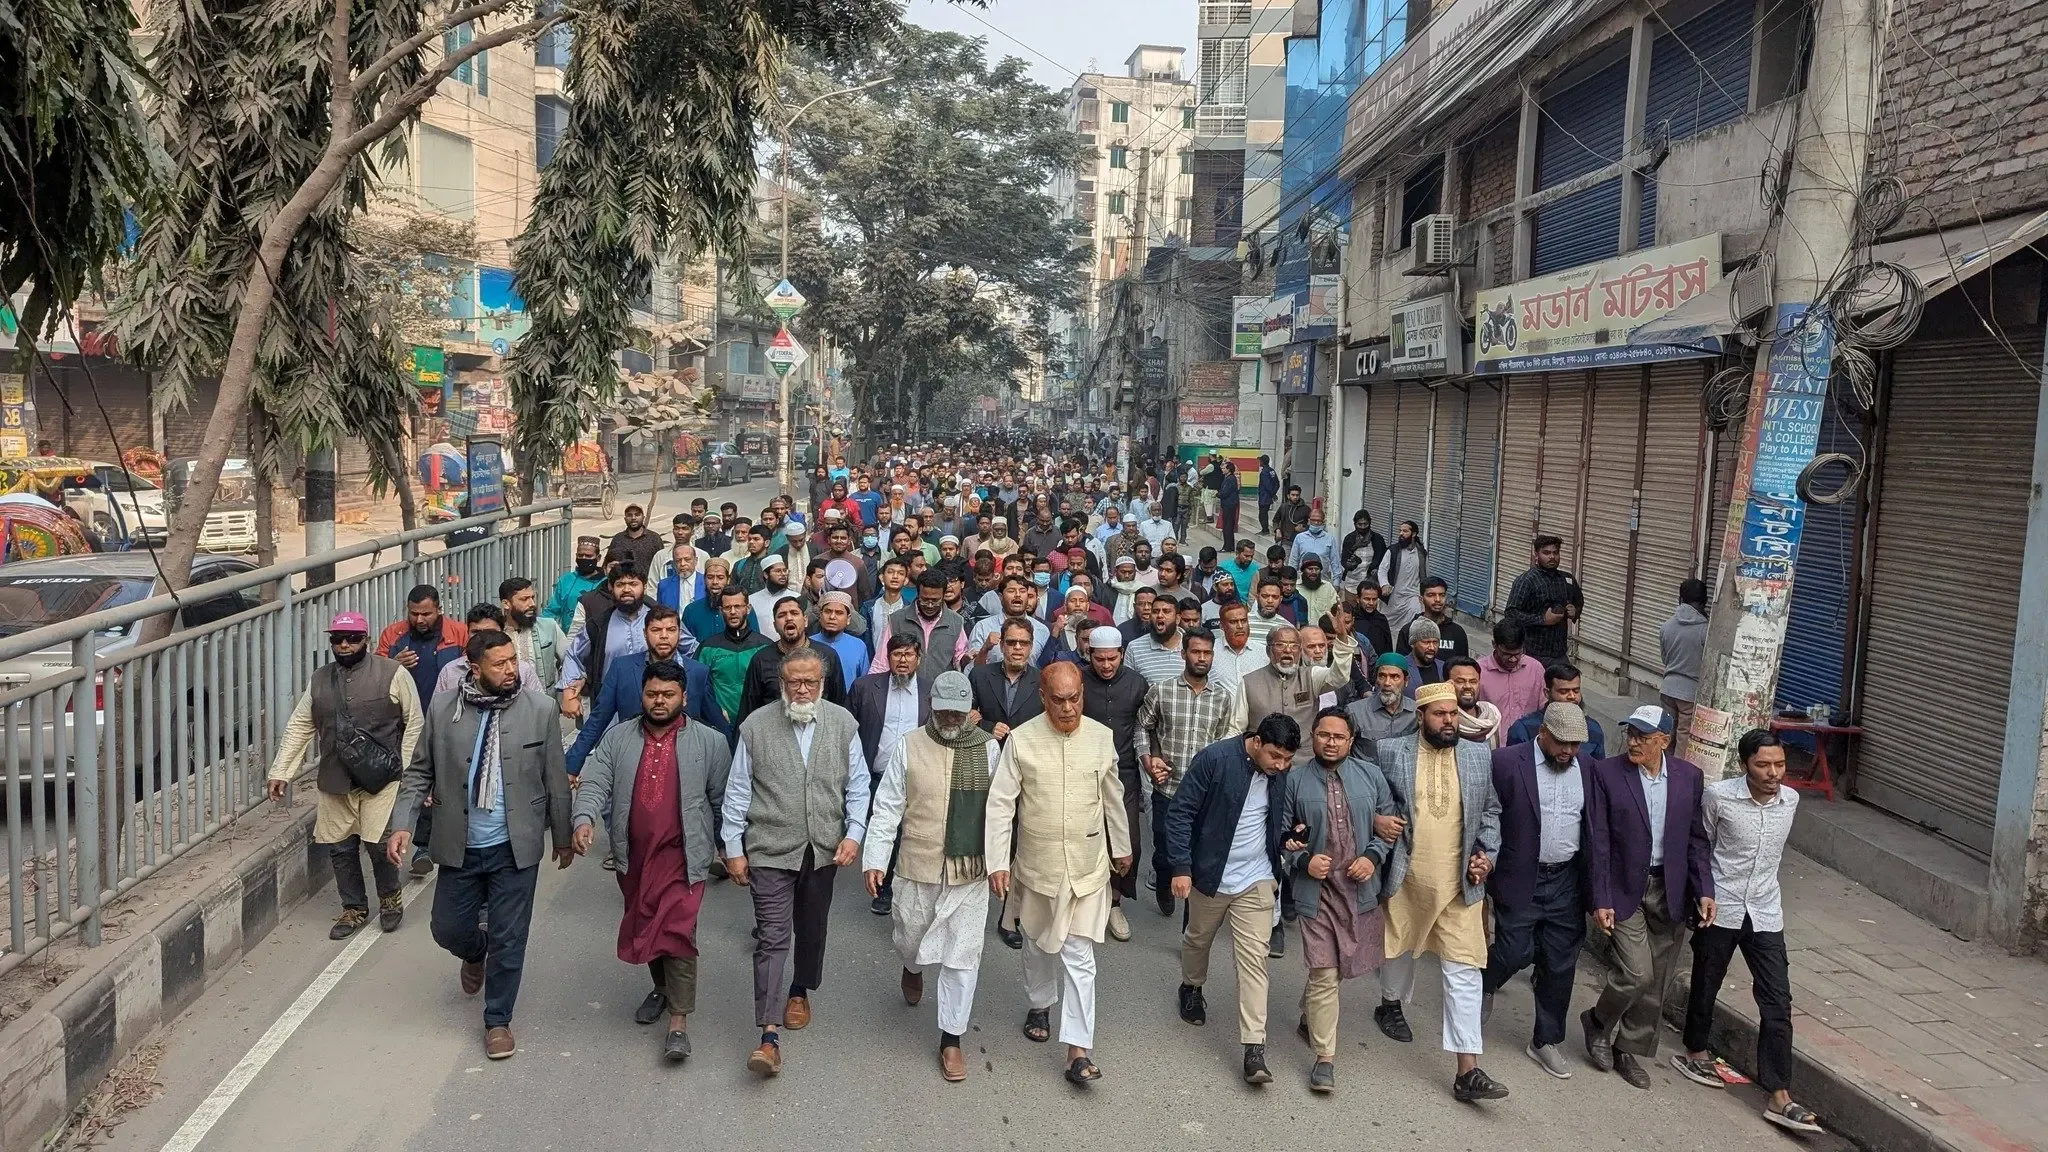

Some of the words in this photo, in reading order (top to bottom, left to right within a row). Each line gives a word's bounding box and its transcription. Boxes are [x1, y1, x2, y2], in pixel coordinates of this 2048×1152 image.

[1520, 269, 1600, 332] মডার্ন
[1600, 257, 1709, 318] মটরস
[1767, 373, 1825, 395] EAST
[1764, 398, 1822, 420] WEST
[1762, 420, 1785, 431] INT'L
[1787, 422, 1818, 434] SCHOOL
[1765, 432, 1772, 442] &
[1775, 433, 1815, 445] COLLEGE
[1759, 442, 1778, 454] Play
[1781, 445, 1789, 453] to
[1792, 446, 1798, 454] A
[1694, 745, 1721, 759] Version
